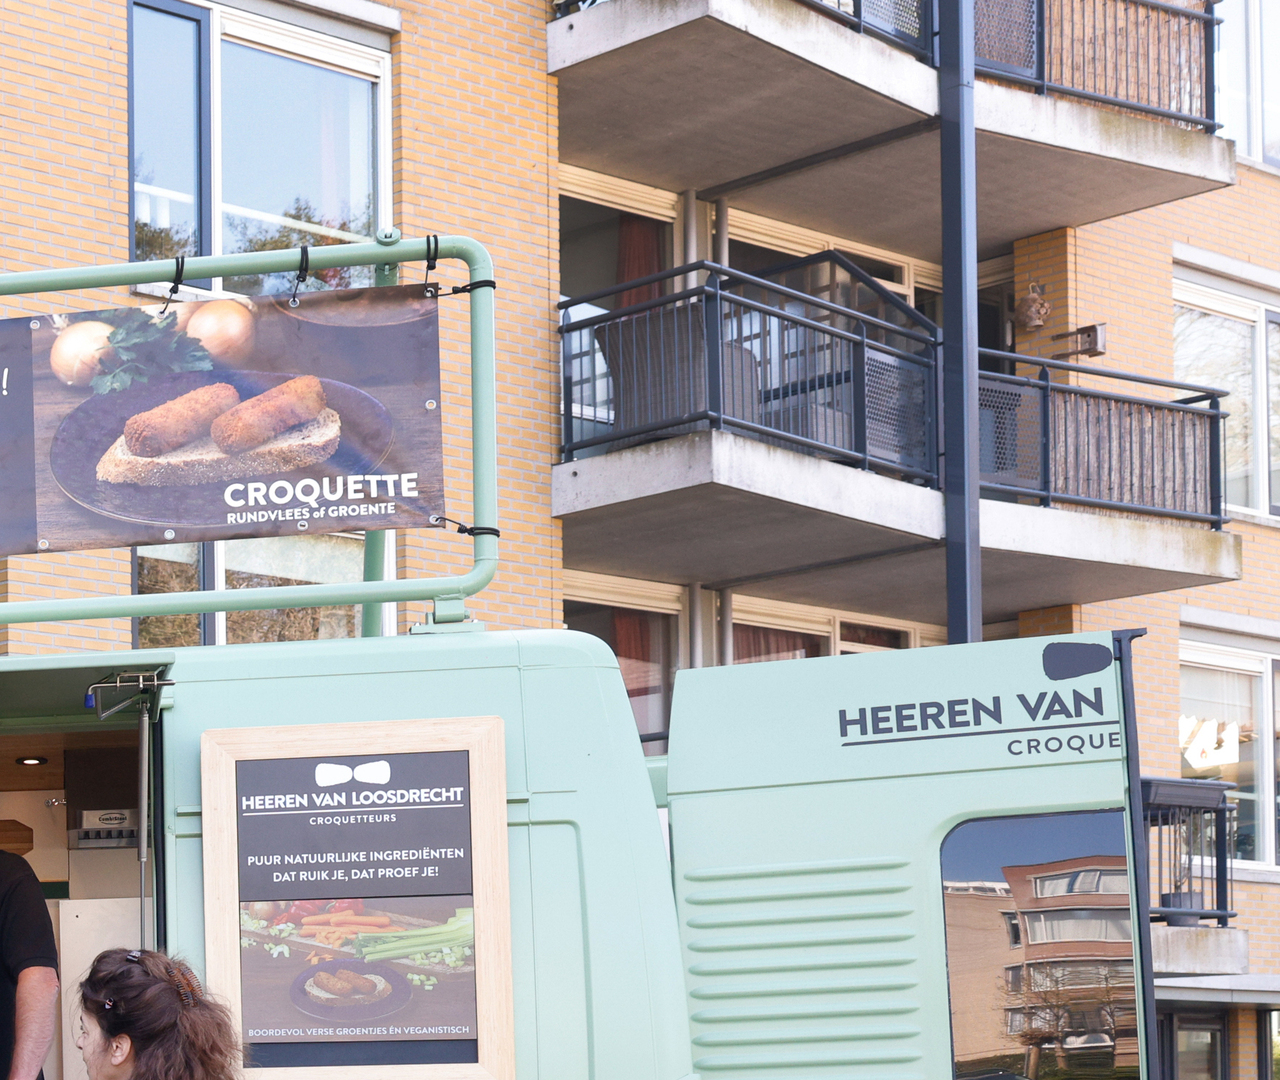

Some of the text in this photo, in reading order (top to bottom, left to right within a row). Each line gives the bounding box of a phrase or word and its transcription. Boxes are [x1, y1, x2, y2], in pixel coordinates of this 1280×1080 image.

[224, 472, 418, 508] CROQUETTE
[227, 502, 395, 524] RUNDVLEES of GROENTE
[839, 687, 1104, 737] HEEREN VAN
[1007, 732, 1121, 756] CROQUE
[242, 787, 464, 810] HEEREN VAN LOOSDRECHT
[309, 814, 397, 826] CROQUETTEURS
[248, 847, 464, 866] PUUR NATUURLIJKE INGREDIËNTEN
[273, 866, 439, 883] DAT RUIK JE, DAT PROEF JE!
[249, 1029, 304, 1037] BOORDEVOL
[306, 1028, 334, 1036] VERSE
[336, 1027, 387, 1035] GROENTJES
[403, 1026, 469, 1034] VEGANISTISCH
